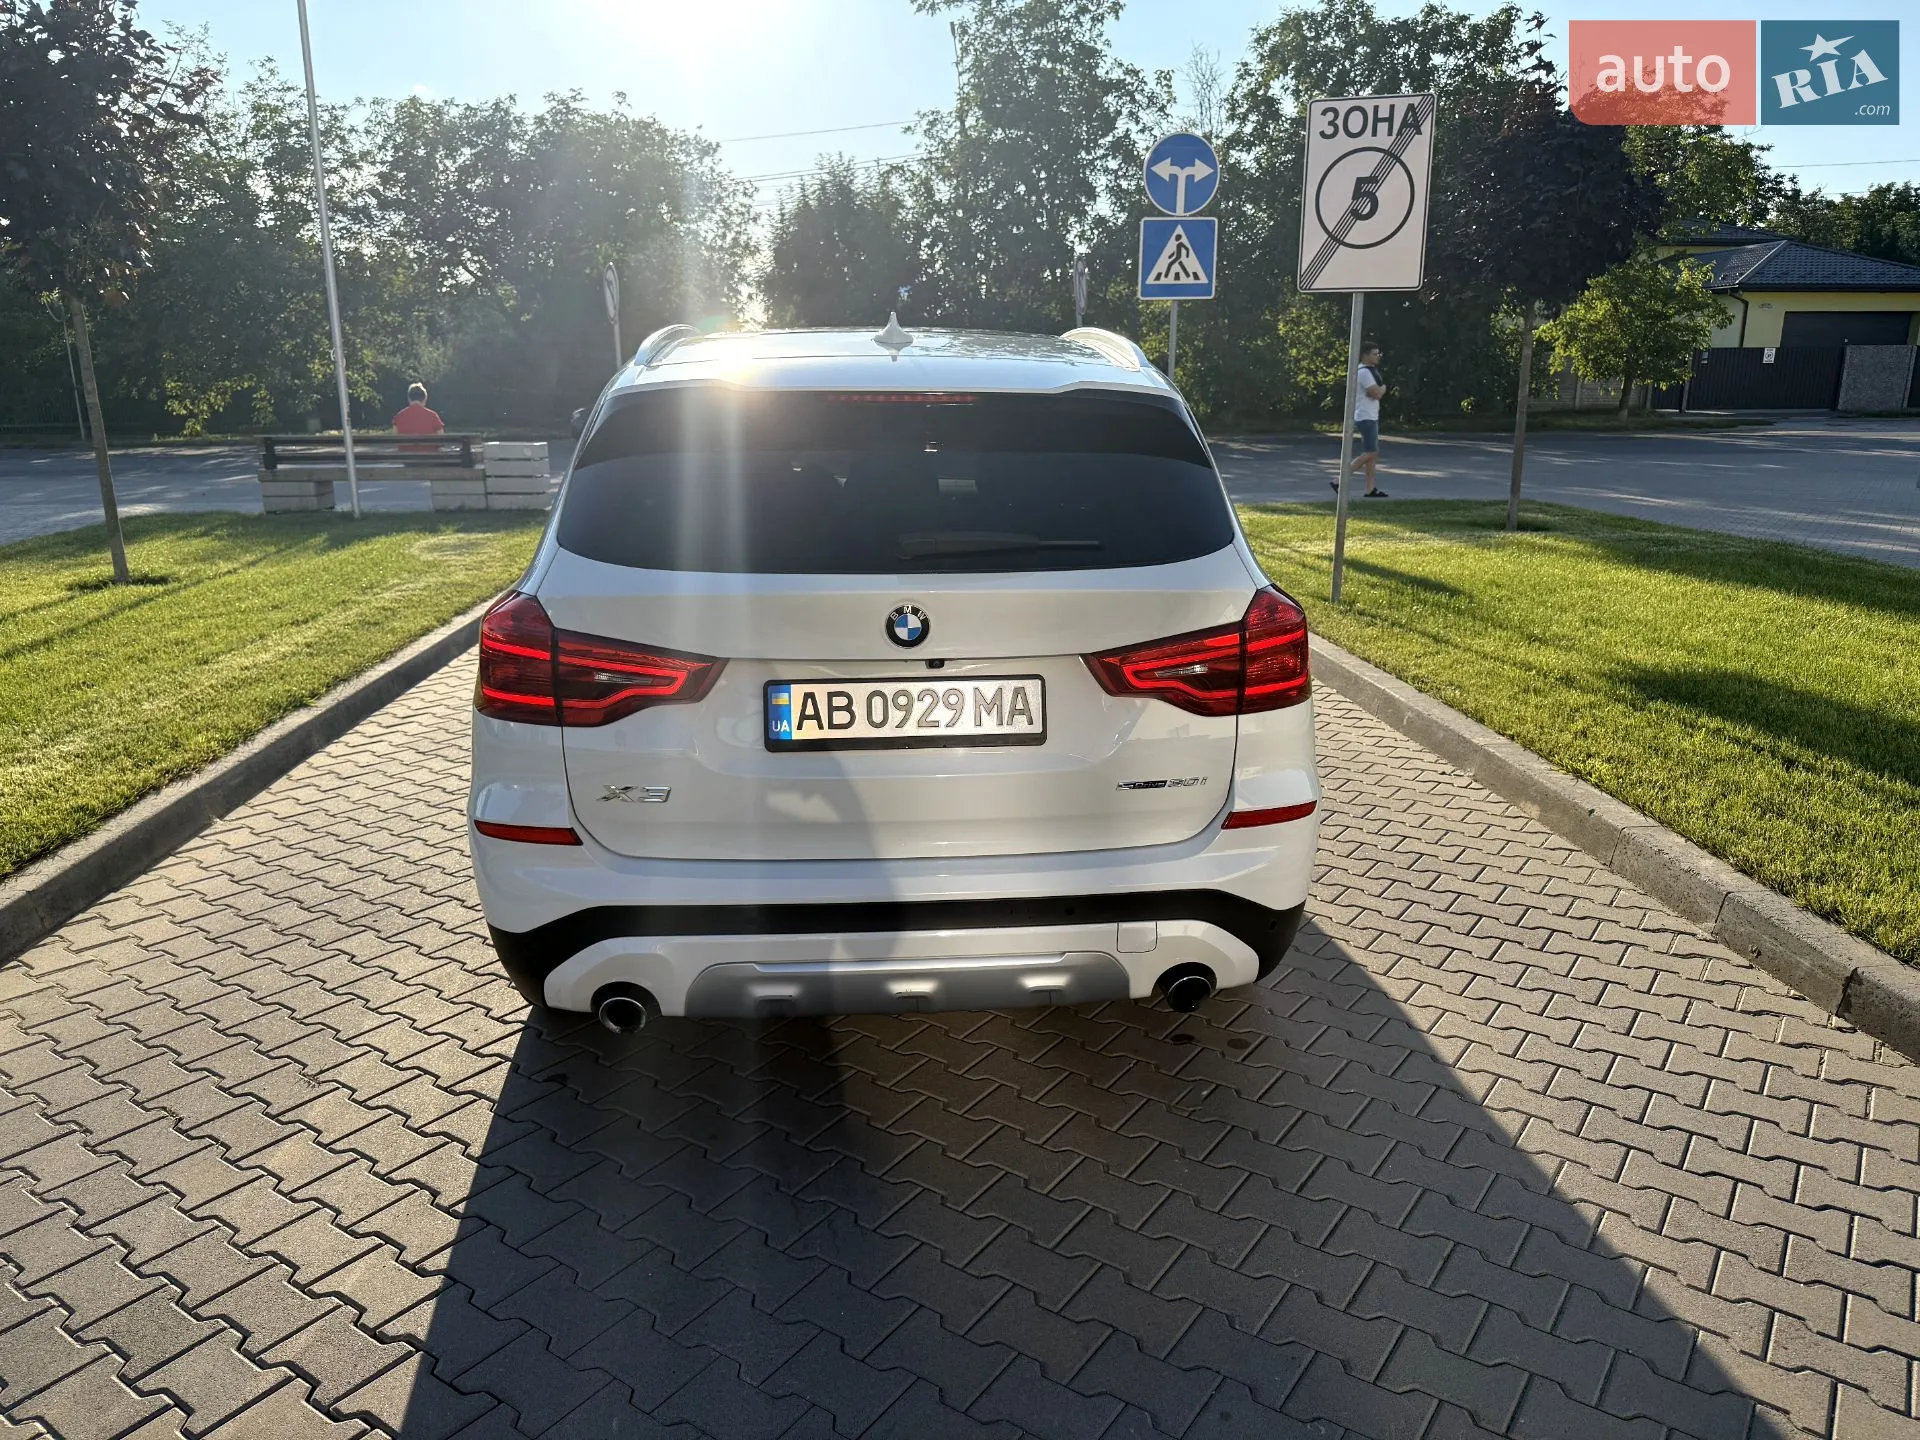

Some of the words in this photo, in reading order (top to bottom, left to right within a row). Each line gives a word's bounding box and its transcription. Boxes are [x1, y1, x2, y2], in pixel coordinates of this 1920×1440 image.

[1319, 103, 1422, 140] ЗОНА
[1350, 176, 1379, 221] 5
[890, 604, 927, 621] BMW
[797, 691, 857, 731] AB
[865, 688, 966, 729] 0929
[973, 686, 1034, 727] MA
[771, 719, 790, 732] UA
[597, 784, 671, 803] X3
